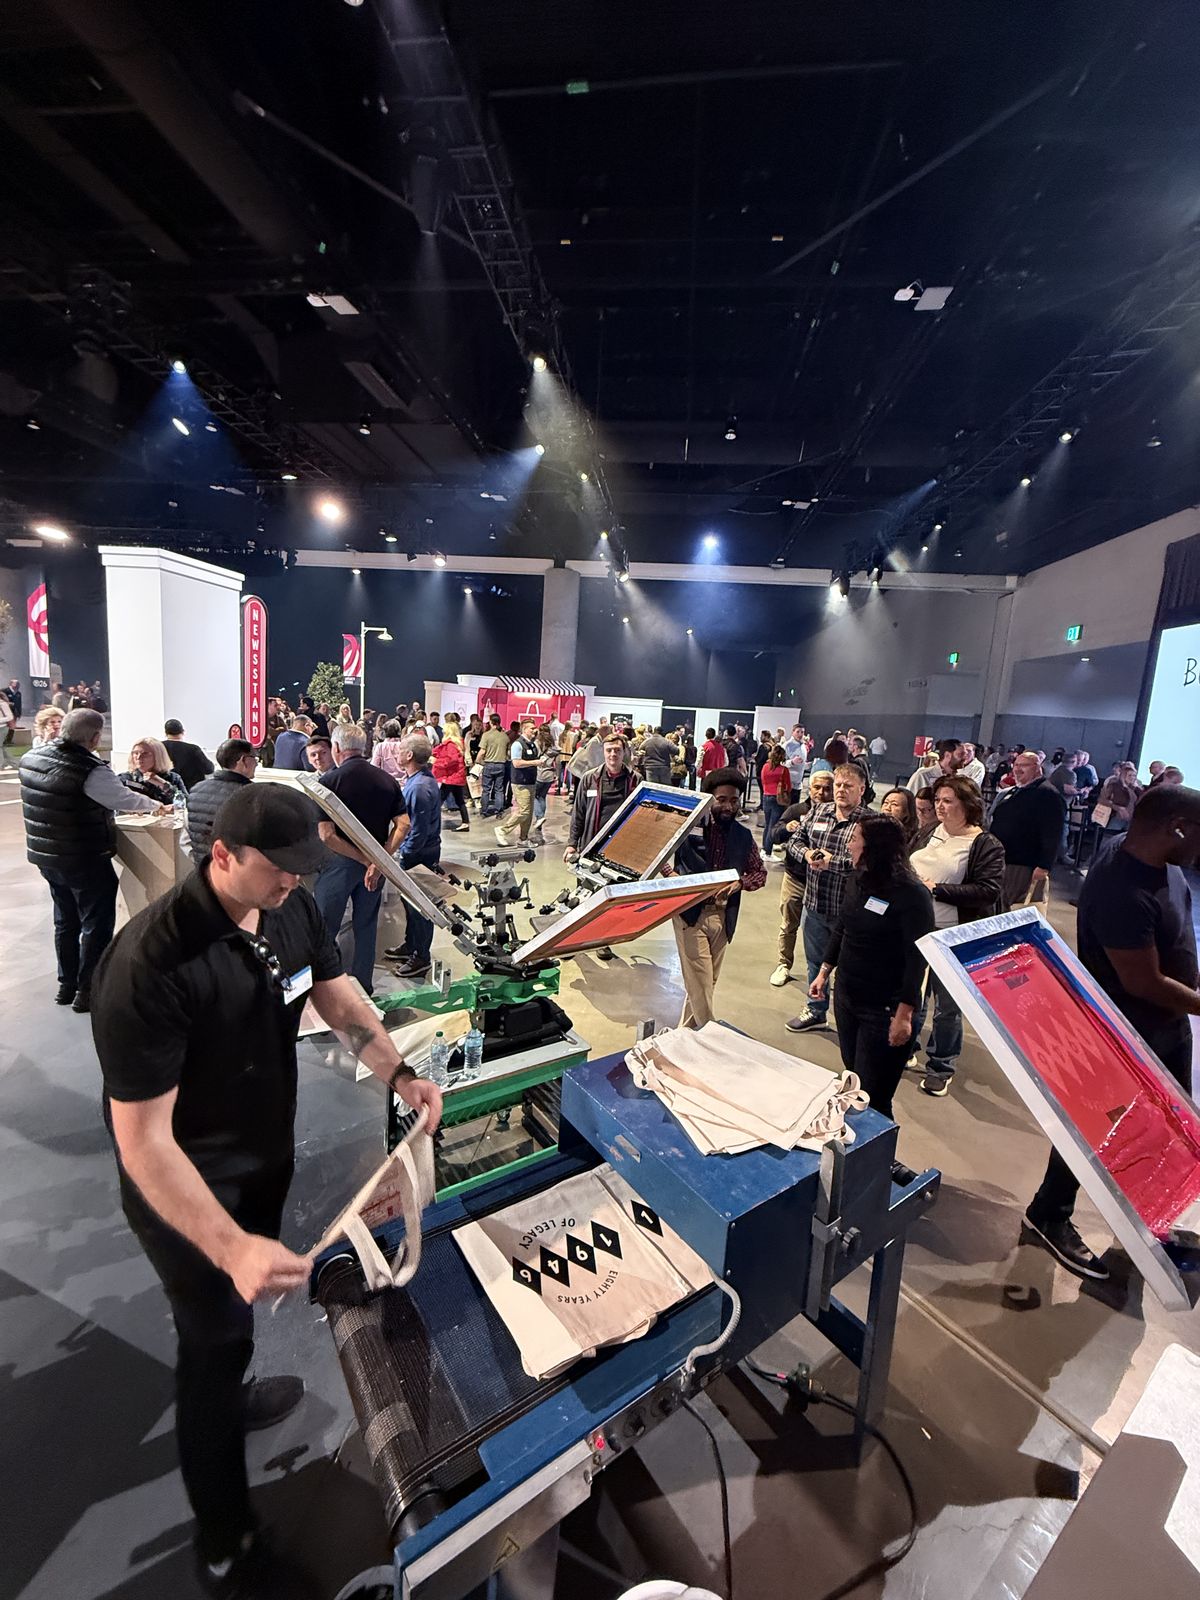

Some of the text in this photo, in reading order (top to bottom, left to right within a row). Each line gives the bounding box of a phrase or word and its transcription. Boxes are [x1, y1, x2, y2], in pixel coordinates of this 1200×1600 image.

[252, 609, 260, 737] NEWSSTAND
[518, 1218, 575, 1250] OF LEGACY
[556, 1270, 618, 1304] EIGHTY YEARS
